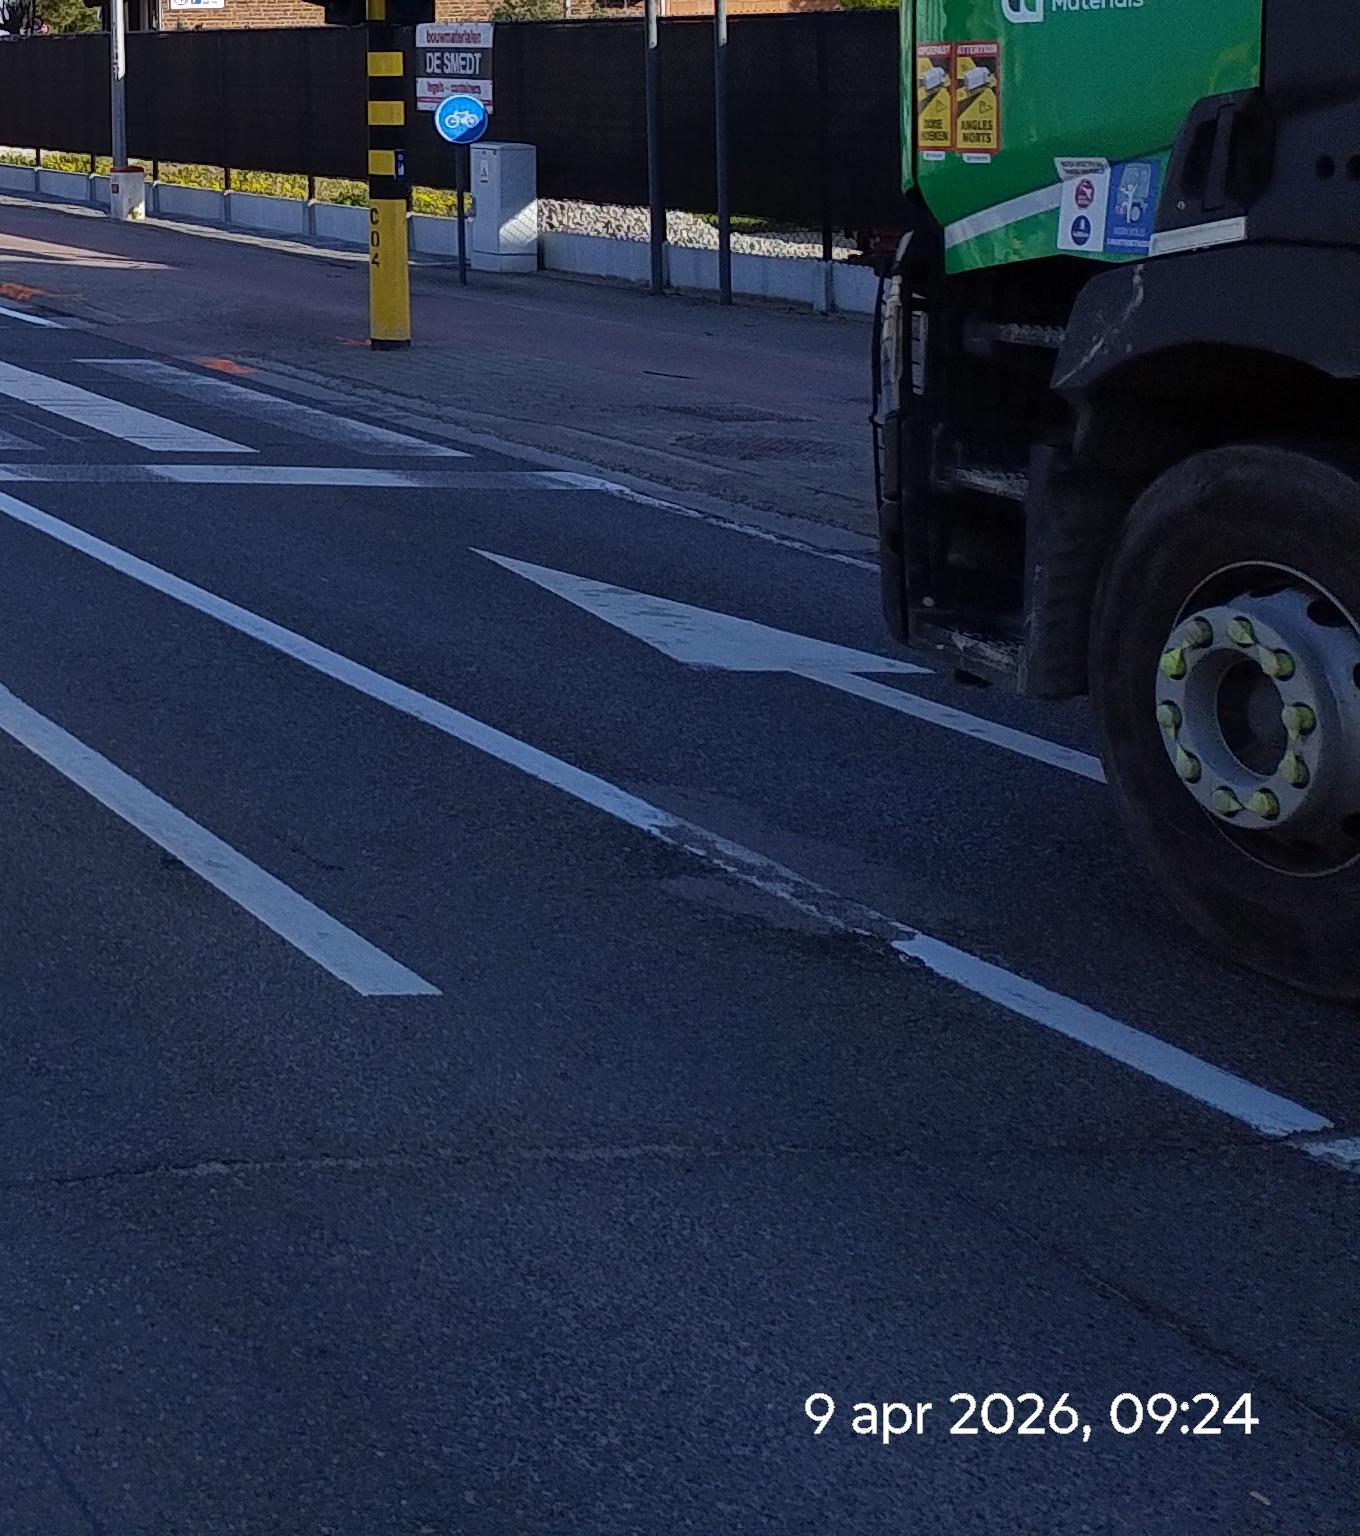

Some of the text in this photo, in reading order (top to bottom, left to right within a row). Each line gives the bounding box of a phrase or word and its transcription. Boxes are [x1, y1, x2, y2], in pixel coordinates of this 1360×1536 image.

[426, 52, 481, 75] DE SMEDT
[961, 120, 993, 130] ANGLES
